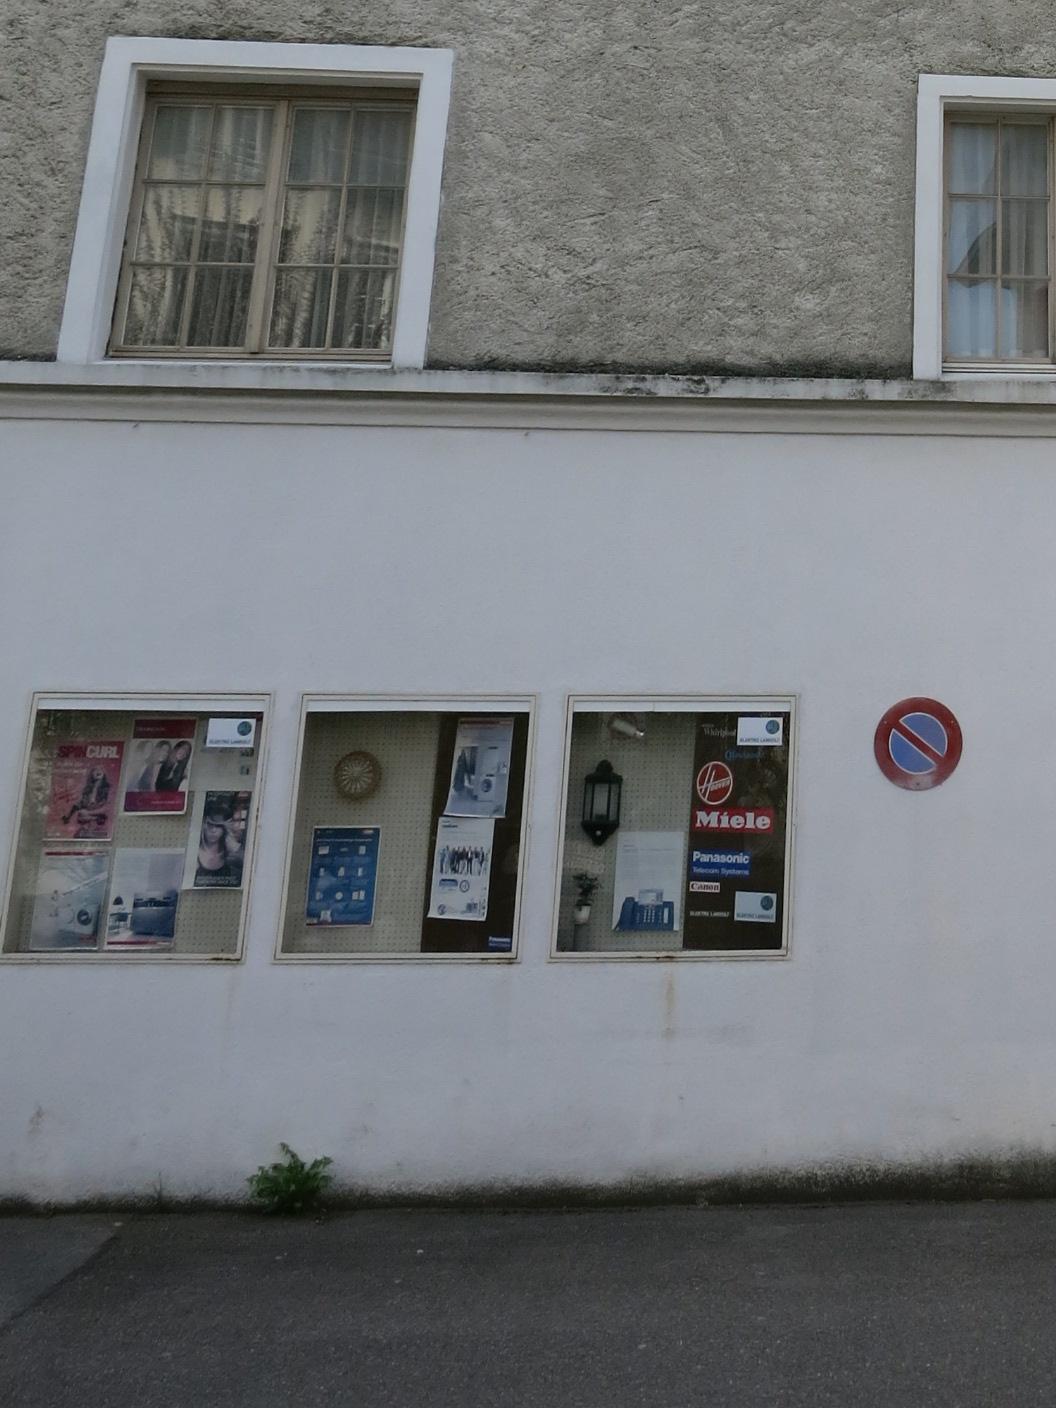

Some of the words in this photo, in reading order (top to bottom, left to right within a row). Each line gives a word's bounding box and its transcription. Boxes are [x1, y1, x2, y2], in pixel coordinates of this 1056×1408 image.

[86, 745, 120, 759] CURL
[695, 811, 771, 829] Miele
[693, 851, 750, 864] Panasonic
[721, 868, 750, 877] Systems
[690, 883, 719, 891] Canon
